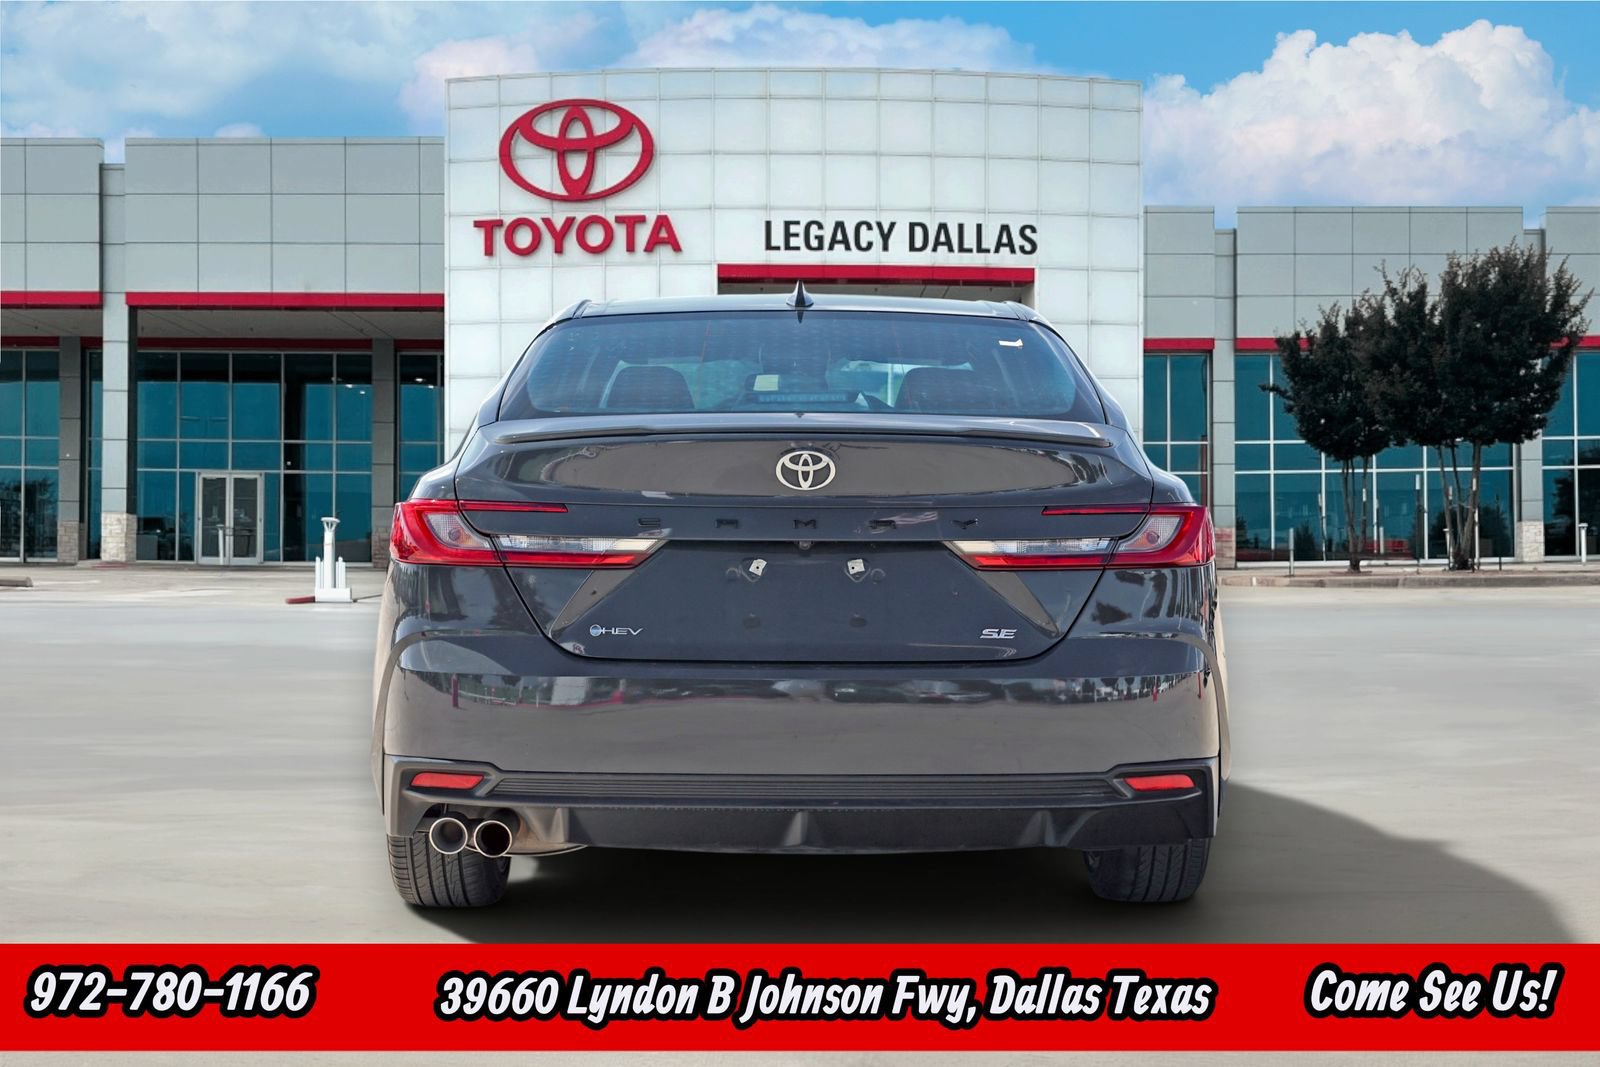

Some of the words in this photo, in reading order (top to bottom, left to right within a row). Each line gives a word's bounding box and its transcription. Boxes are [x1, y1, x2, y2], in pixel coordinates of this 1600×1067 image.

[474, 214, 682, 256] TOYOTA
[764, 220, 898, 252] LEGACY
[908, 221, 1038, 255] DALLAS
[980, 628, 1017, 639] SE
